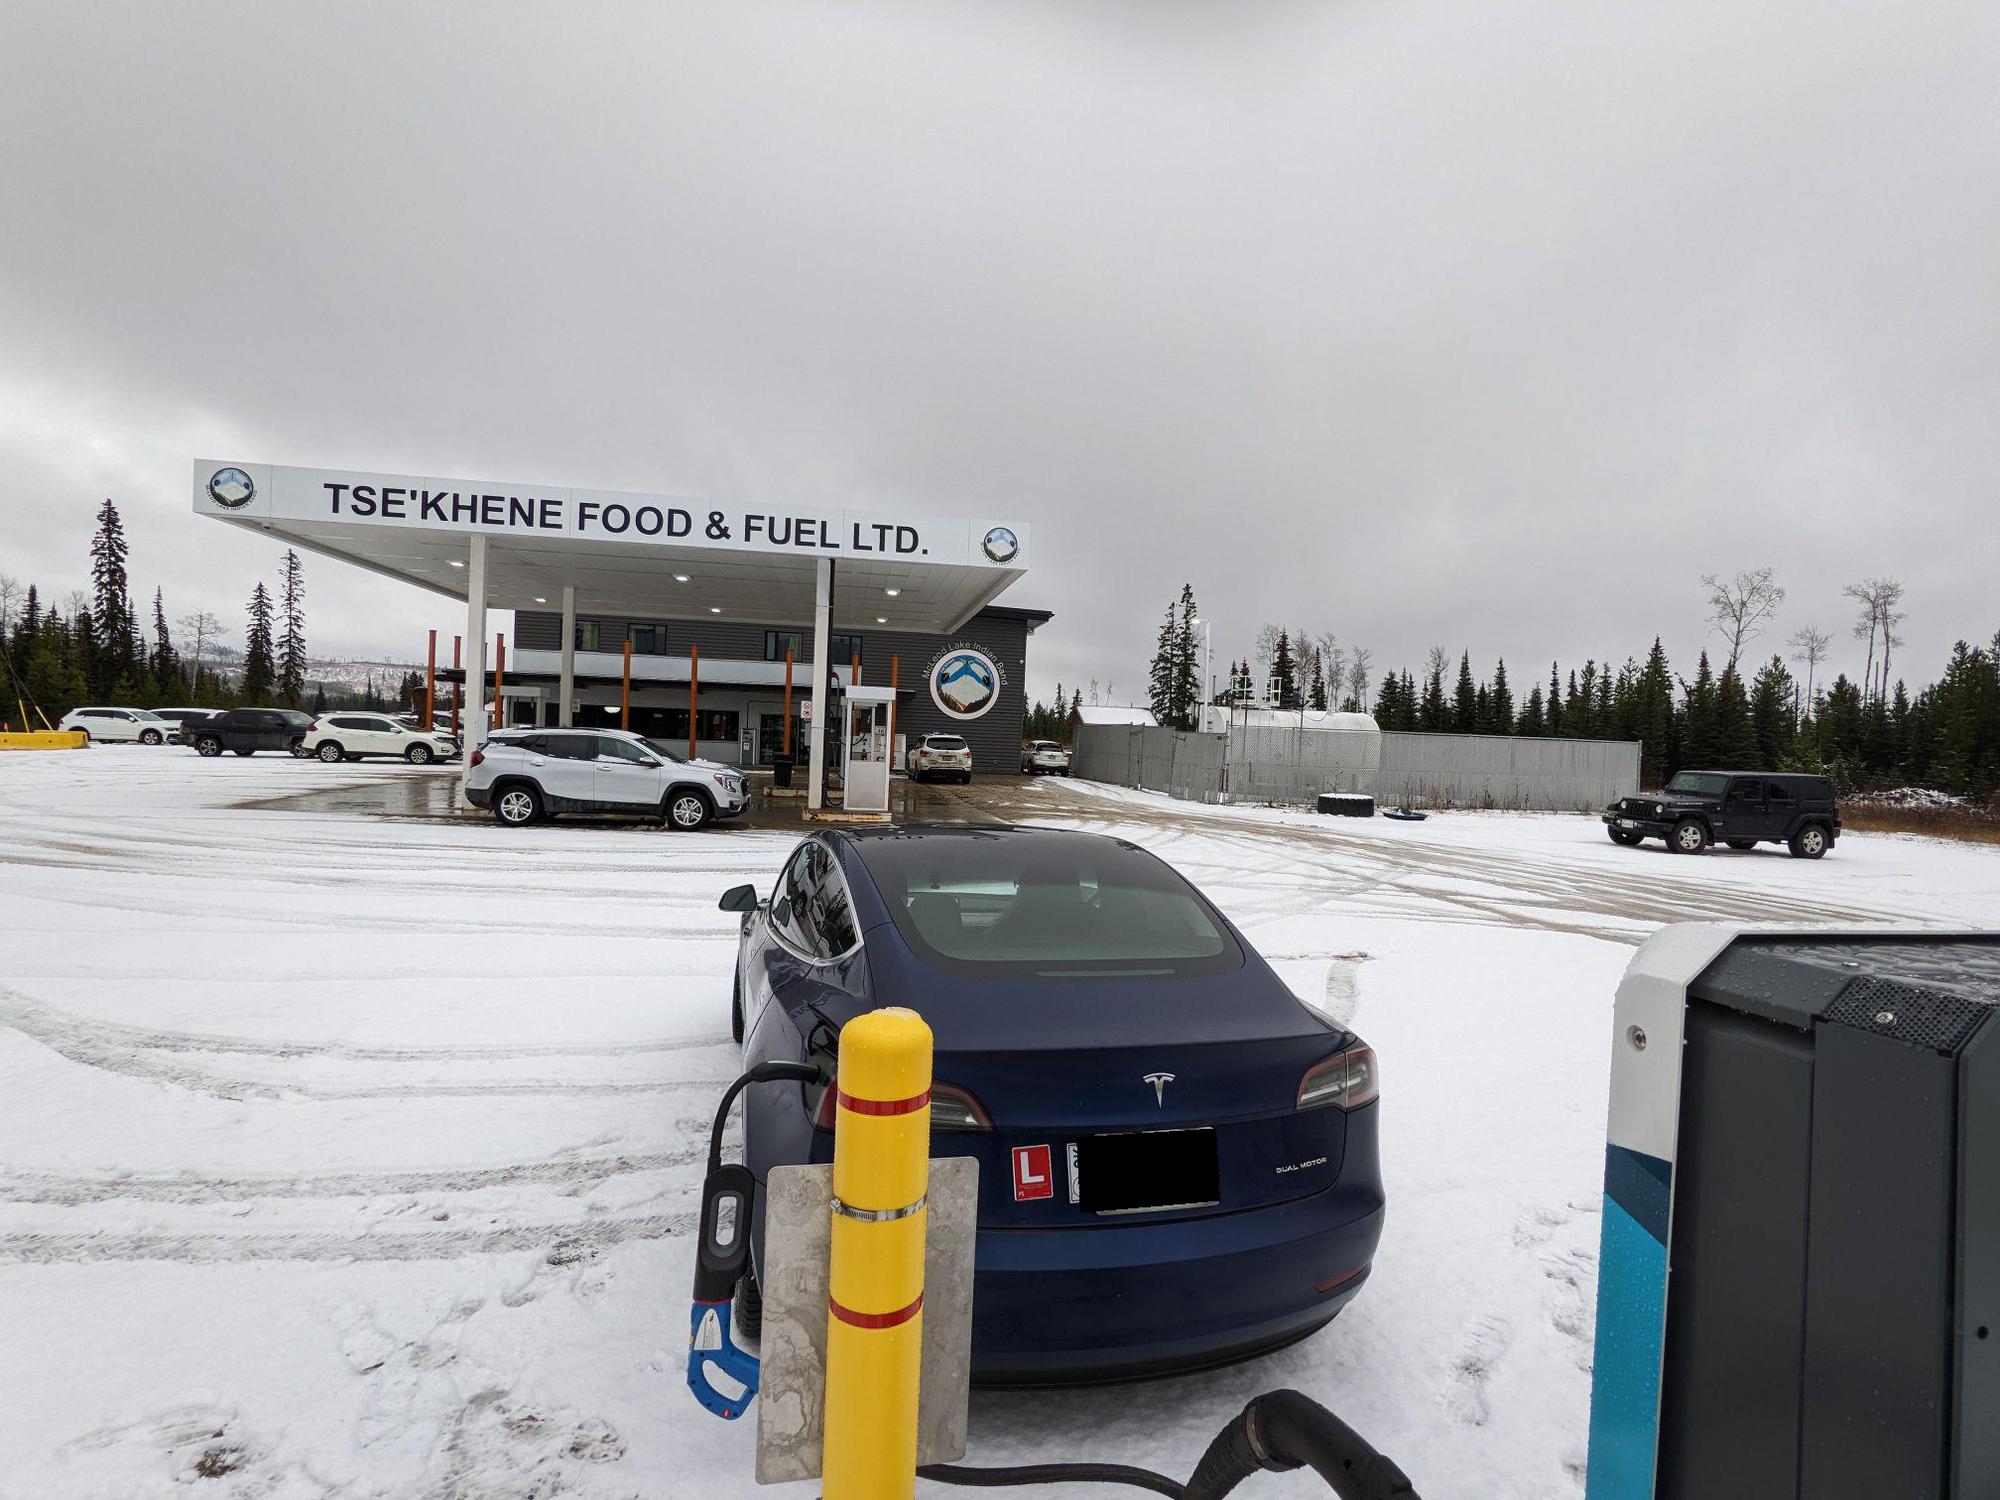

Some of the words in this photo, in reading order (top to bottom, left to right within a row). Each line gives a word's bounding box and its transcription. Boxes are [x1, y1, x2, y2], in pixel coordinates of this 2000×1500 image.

[323, 482, 563, 530] TSE'KHENE
[578, 502, 692, 538] FOOD
[705, 511, 731, 540] &
[744, 514, 840, 549] FUEL
[853, 522, 928, 555] LTD.
[922, 646, 948, 680] McLeod
[948, 641, 970, 651] Lake
[974, 642, 998, 662] Indian
[996, 662, 1009, 686] Band
[1020, 1151, 1045, 1184] L
[1275, 1165, 1299, 1174] DUAL
[1300, 1157, 1327, 1168] MOTOR
